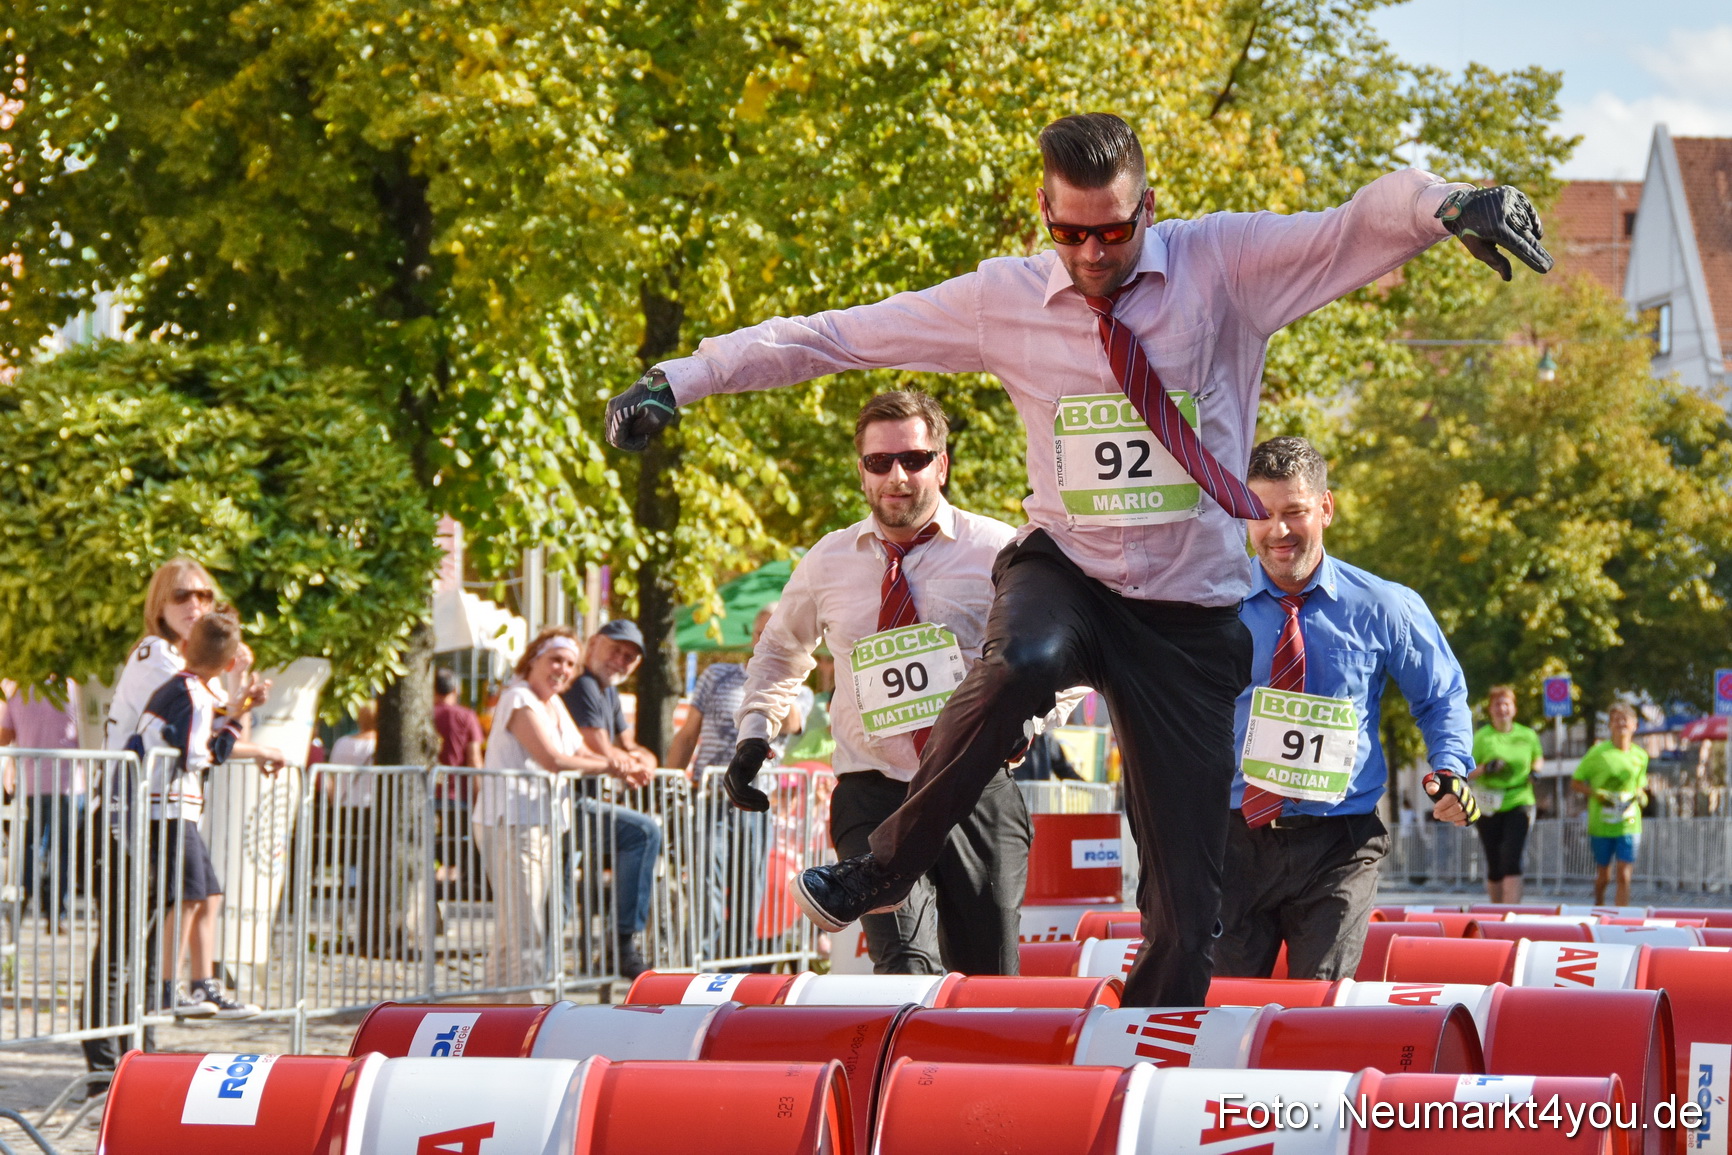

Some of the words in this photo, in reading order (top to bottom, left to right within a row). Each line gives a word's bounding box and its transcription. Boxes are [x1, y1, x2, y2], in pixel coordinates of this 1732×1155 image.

[1060, 398, 1160, 430] BOC
[1095, 440, 1152, 481] 92
[1092, 492, 1164, 511] MARIO
[857, 627, 946, 667] BOCK
[882, 662, 929, 698] 90
[1261, 693, 1353, 727] BOCK
[1281, 730, 1324, 764] 91
[1266, 768, 1330, 788] ADRIAN
[777, 1096, 794, 1118] 323
